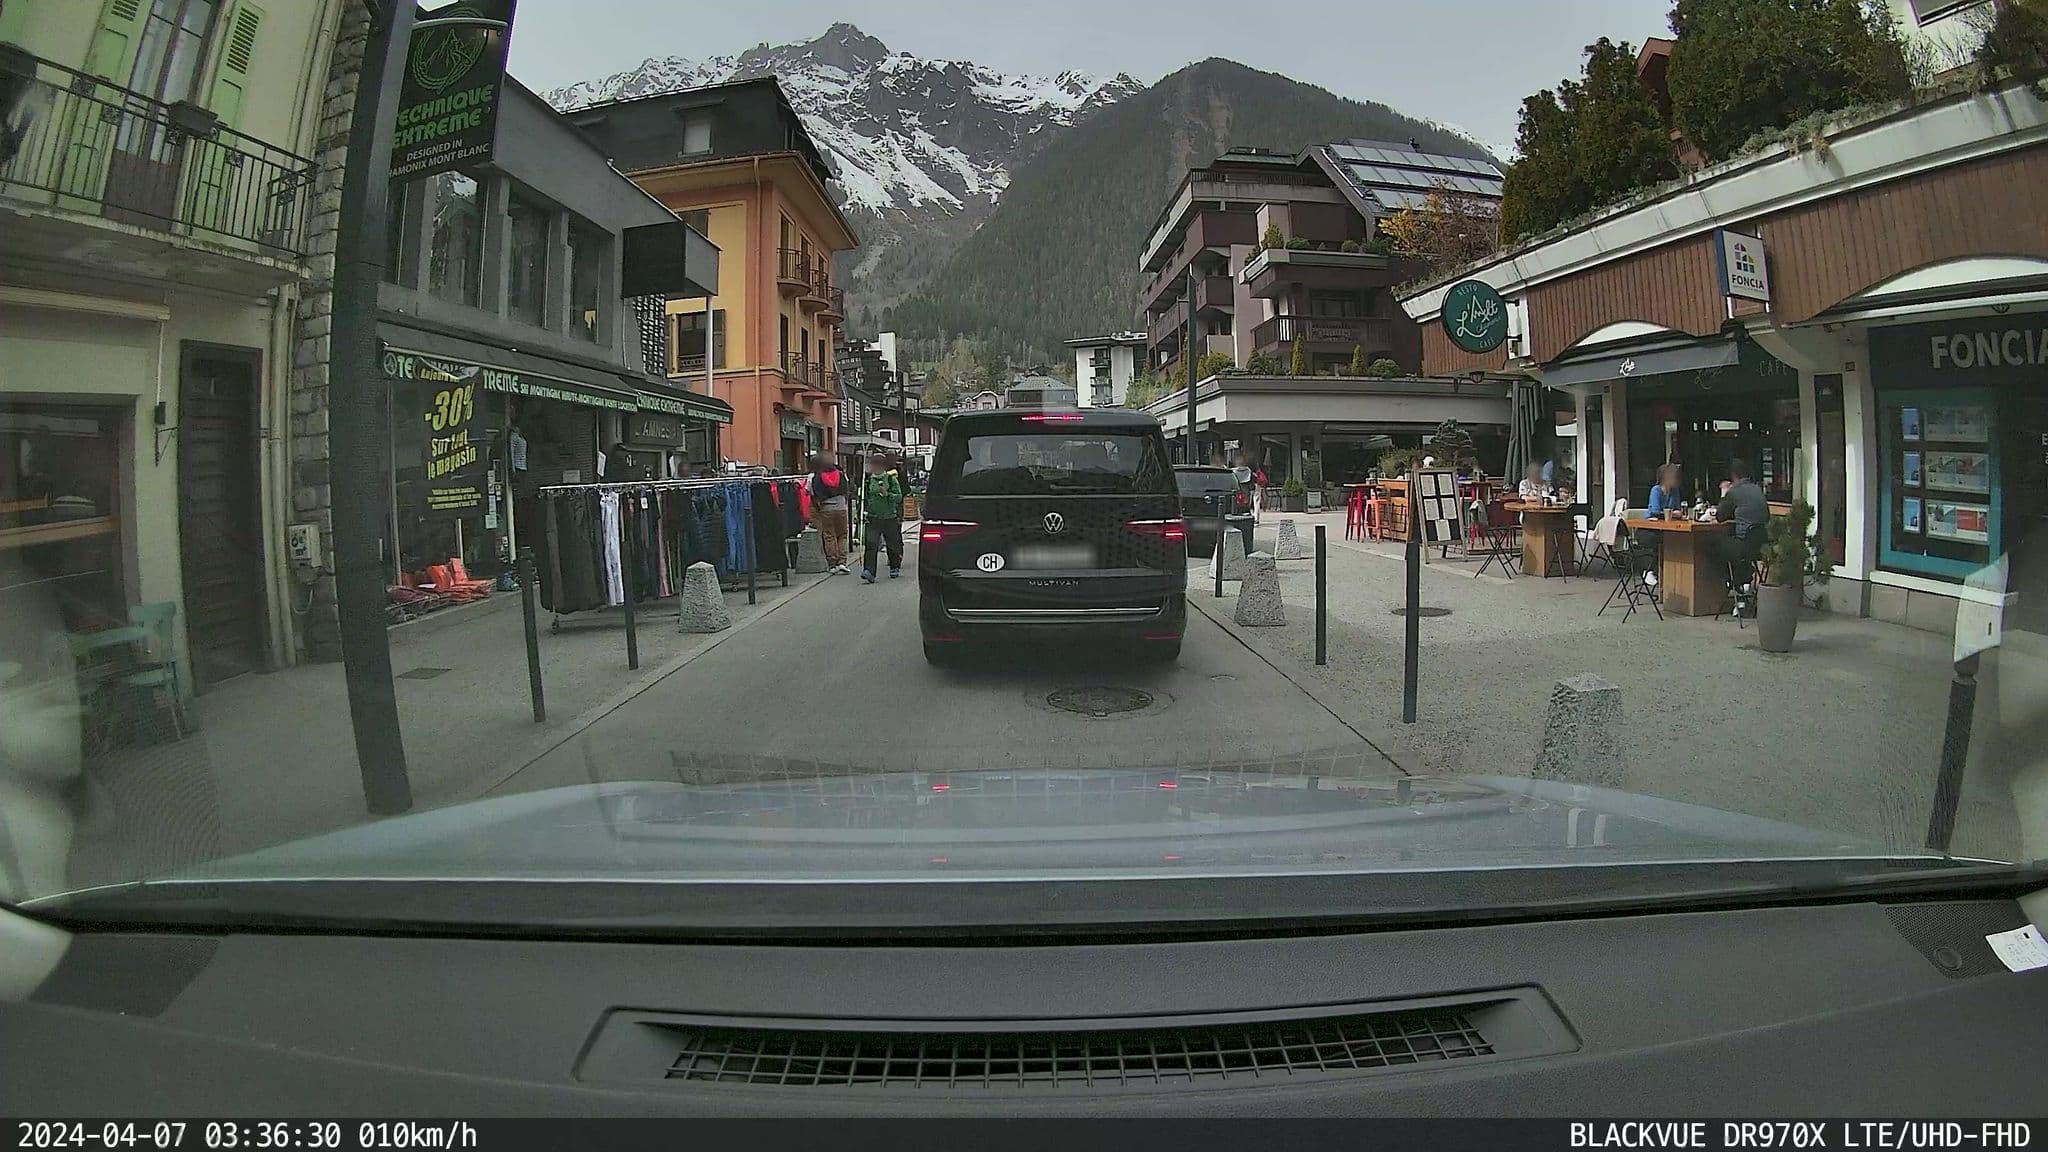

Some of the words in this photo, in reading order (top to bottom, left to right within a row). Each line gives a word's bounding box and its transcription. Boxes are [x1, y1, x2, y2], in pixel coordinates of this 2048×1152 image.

[397, 84, 495, 126] ECHNIQUE
[406, 142, 451, 161] DESIGNED
[451, 139, 463, 150] IN
[428, 150, 458, 167] MONT
[457, 143, 489, 159] BLANC
[1732, 274, 1765, 290] FONCIA
[424, 383, 475, 431] -30%
[435, 446, 477, 476] magasin
[983, 556, 998, 569] CH
[1028, 579, 1080, 587] MULTIVAN
